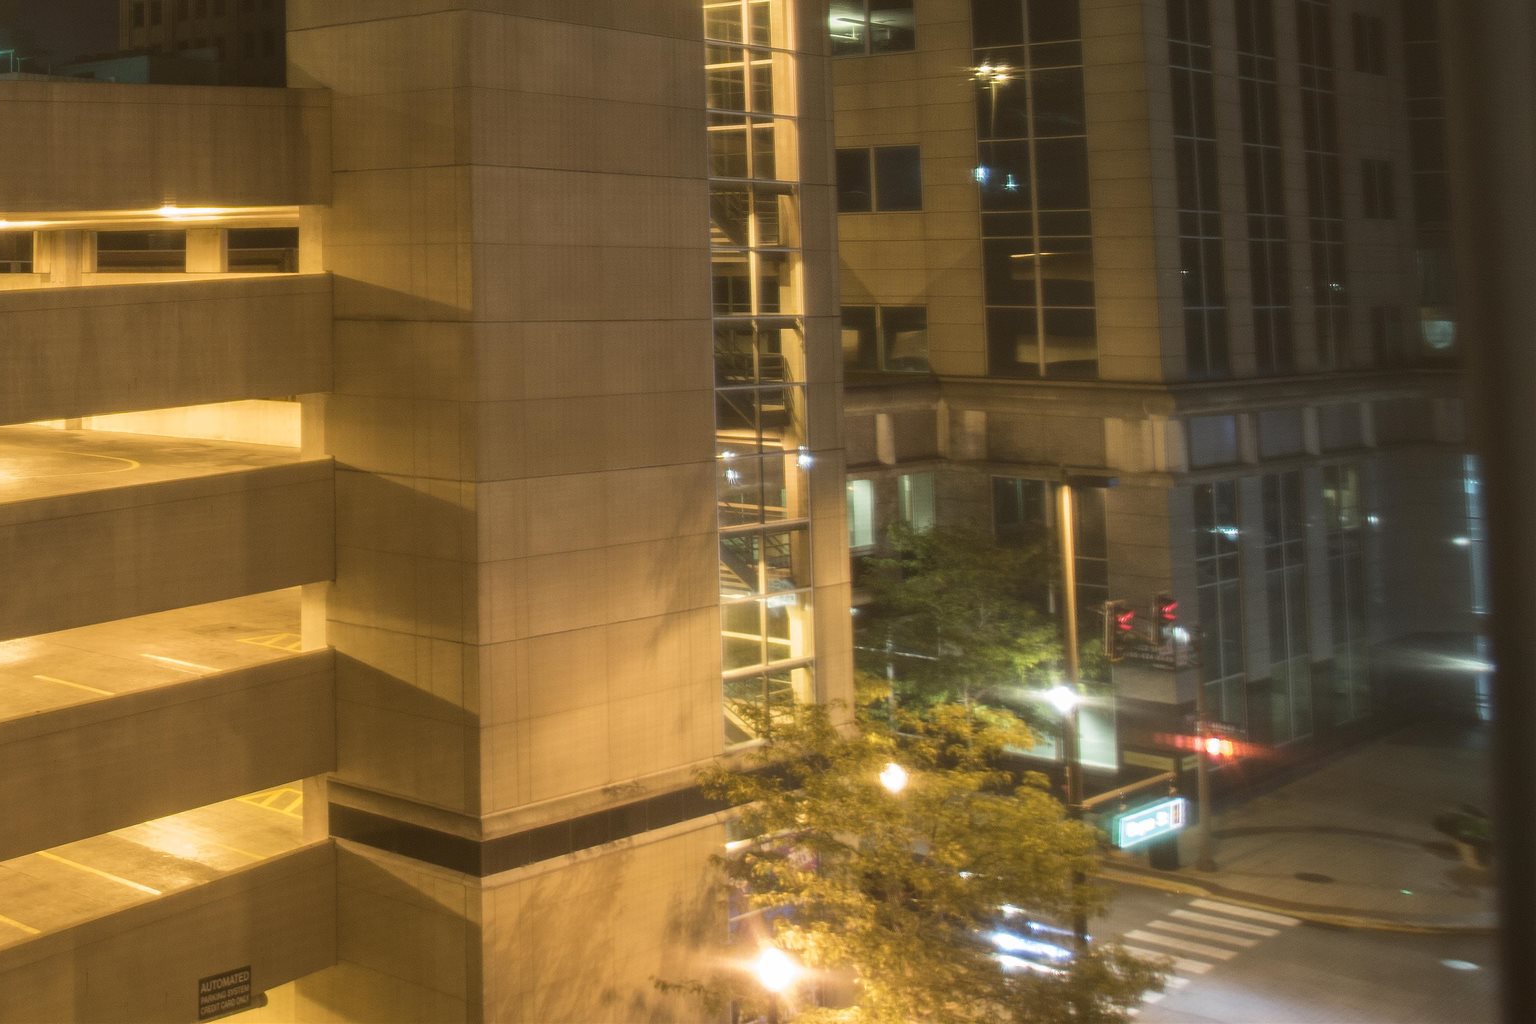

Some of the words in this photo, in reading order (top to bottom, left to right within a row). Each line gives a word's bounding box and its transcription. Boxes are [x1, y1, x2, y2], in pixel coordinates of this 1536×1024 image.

[200, 971, 249, 994] AUTOMATED
[200, 990, 227, 1006] PARKING
[200, 1003, 220, 1015] CREDIT
[221, 998, 236, 1009] CARD
